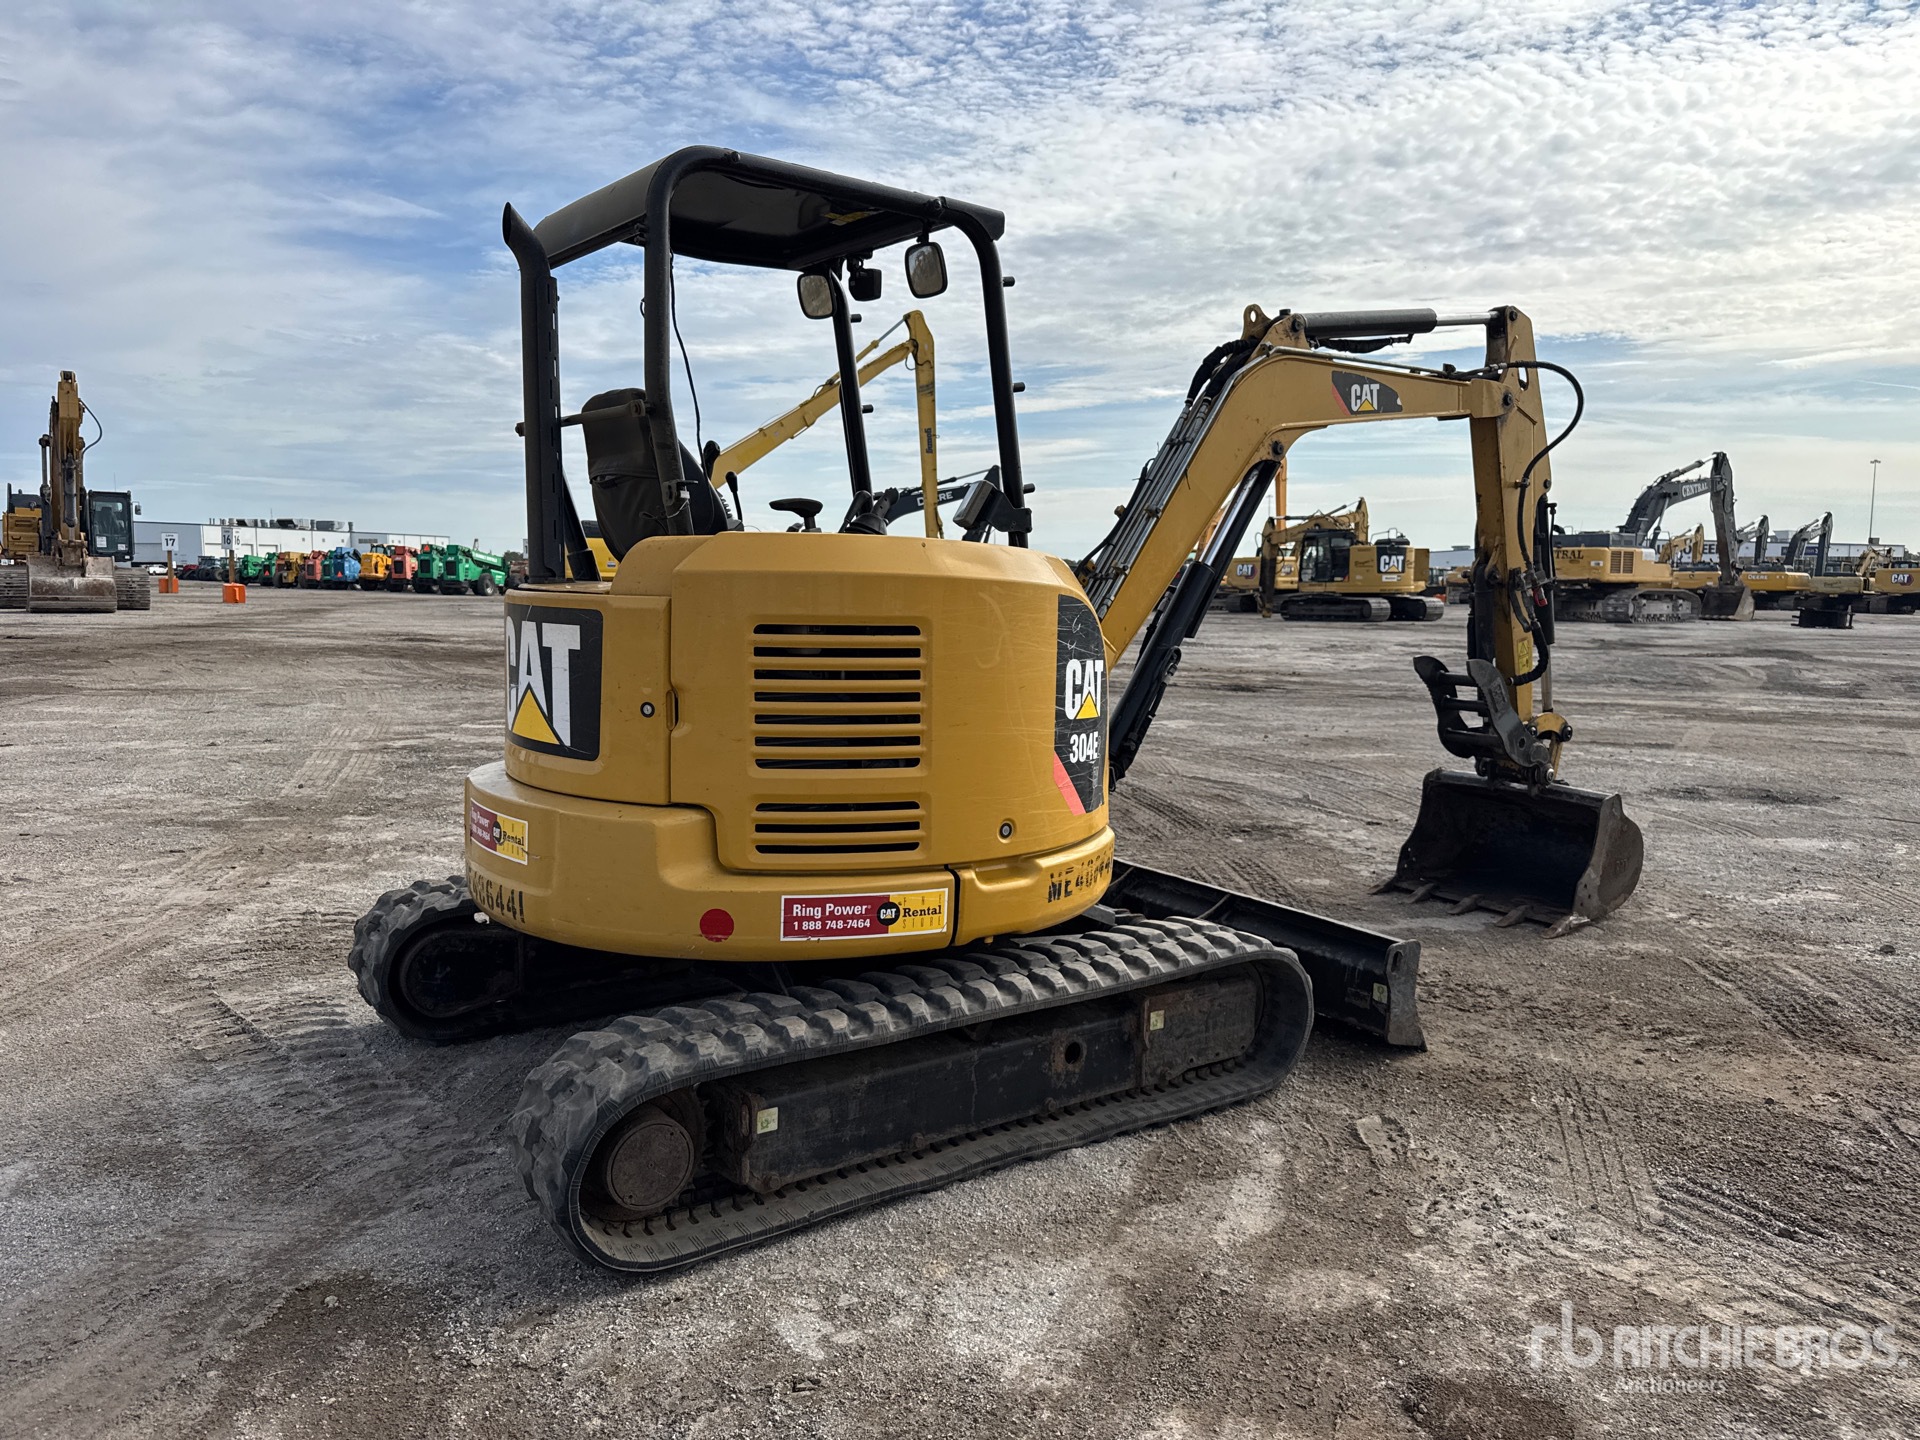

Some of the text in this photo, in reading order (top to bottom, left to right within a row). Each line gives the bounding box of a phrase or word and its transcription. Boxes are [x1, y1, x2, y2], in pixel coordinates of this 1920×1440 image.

[1351, 384, 1379, 411] CAT
[1682, 483, 1708, 497] CENTRAL
[917, 491, 953, 506] DRE
[165, 538, 175, 546] 17
[223, 534, 231, 545] 16
[234, 535, 240, 545] 16
[1554, 550, 1584, 559] TRAL
[1236, 564, 1253, 576] CAT
[1380, 555, 1404, 572] CAT
[1892, 573, 1909, 583] CAT
[506, 616, 581, 746] CAT
[1065, 659, 1103, 720] CAT
[1069, 731, 1099, 763] 304E
[503, 830, 524, 846] Rental
[793, 903, 868, 919] Ring Power
[880, 908, 896, 920] CAT
[902, 905, 942, 918] Rental
[793, 918, 870, 930] 1 888 748-7464
